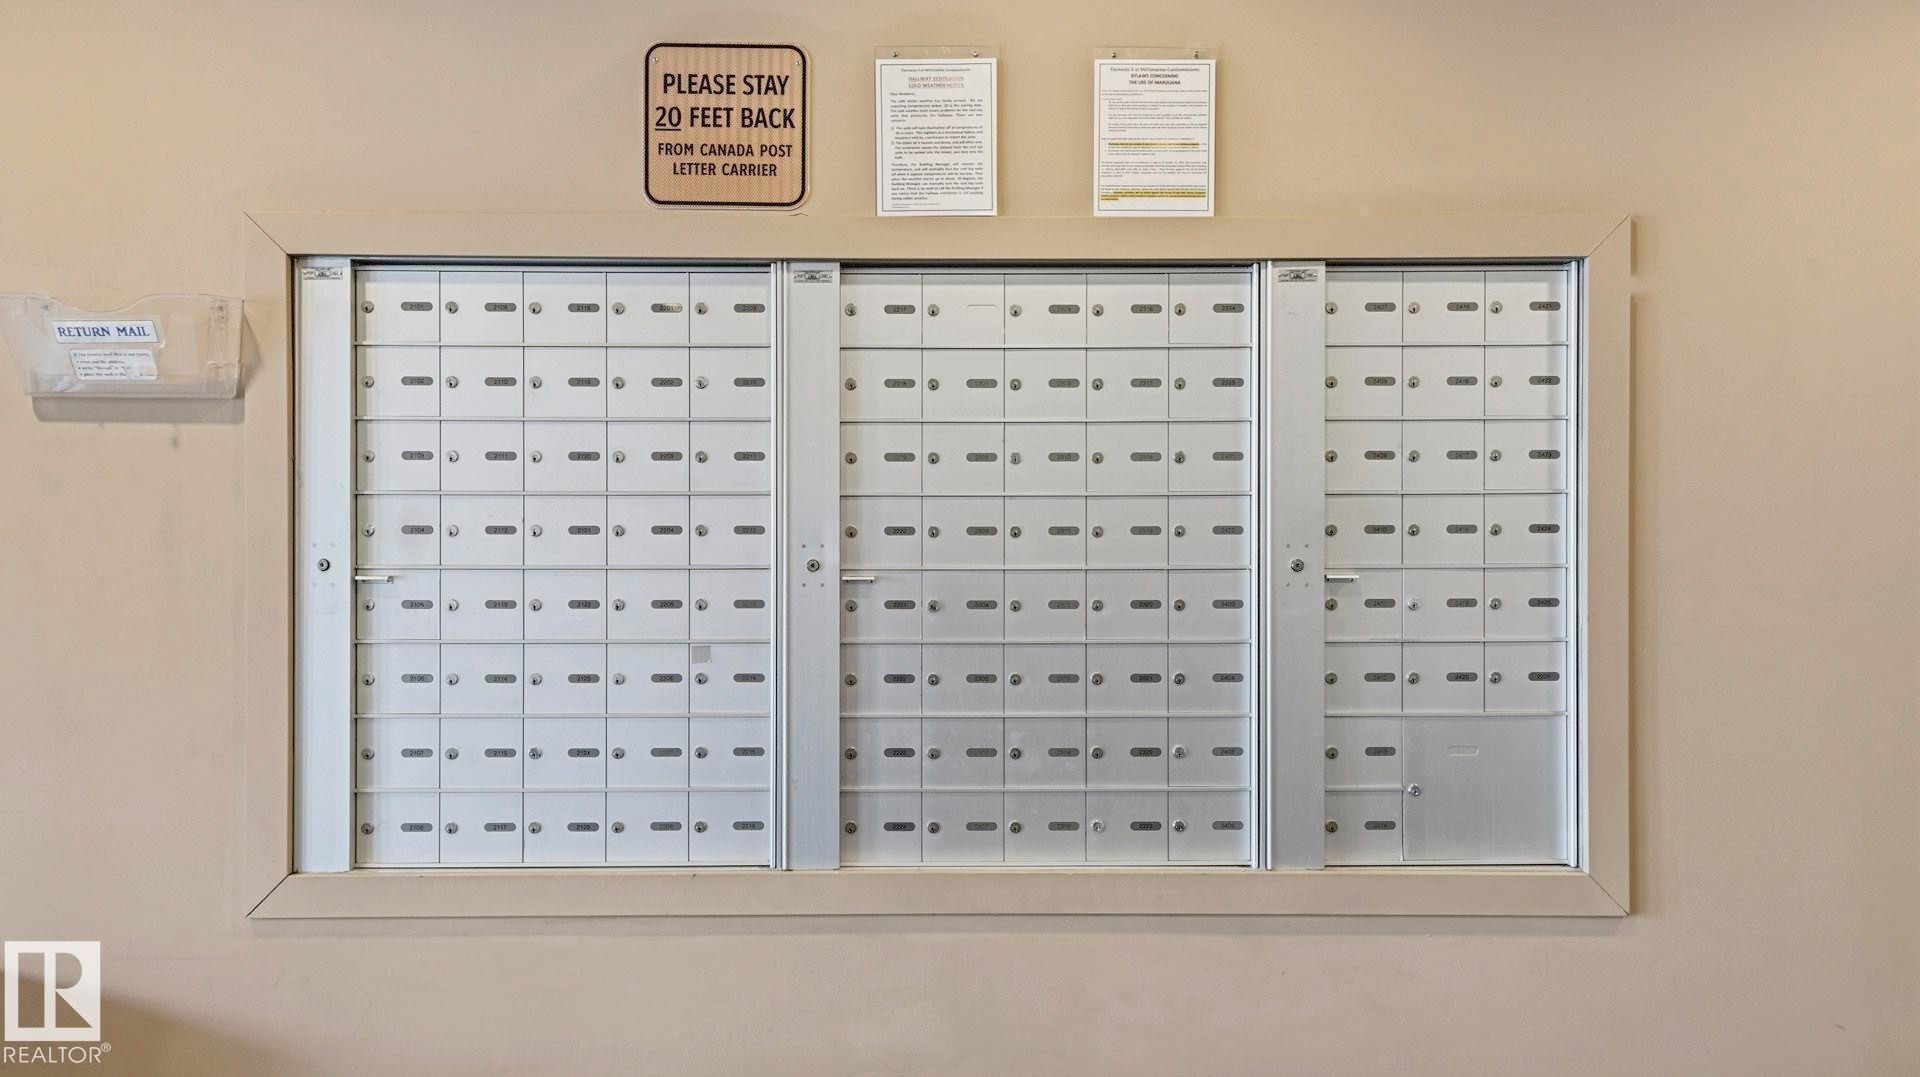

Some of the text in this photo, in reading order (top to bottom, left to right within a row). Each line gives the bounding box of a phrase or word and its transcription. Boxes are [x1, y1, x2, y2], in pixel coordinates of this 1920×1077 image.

[663, 73, 790, 96] PLEASE STAY
[655, 106, 796, 129] 20 FEET BACK
[658, 143, 793, 158] FROM CANADA POST
[673, 162, 777, 176] LETTER CARRIER
[57, 326, 150, 337] RETURN MAIL
